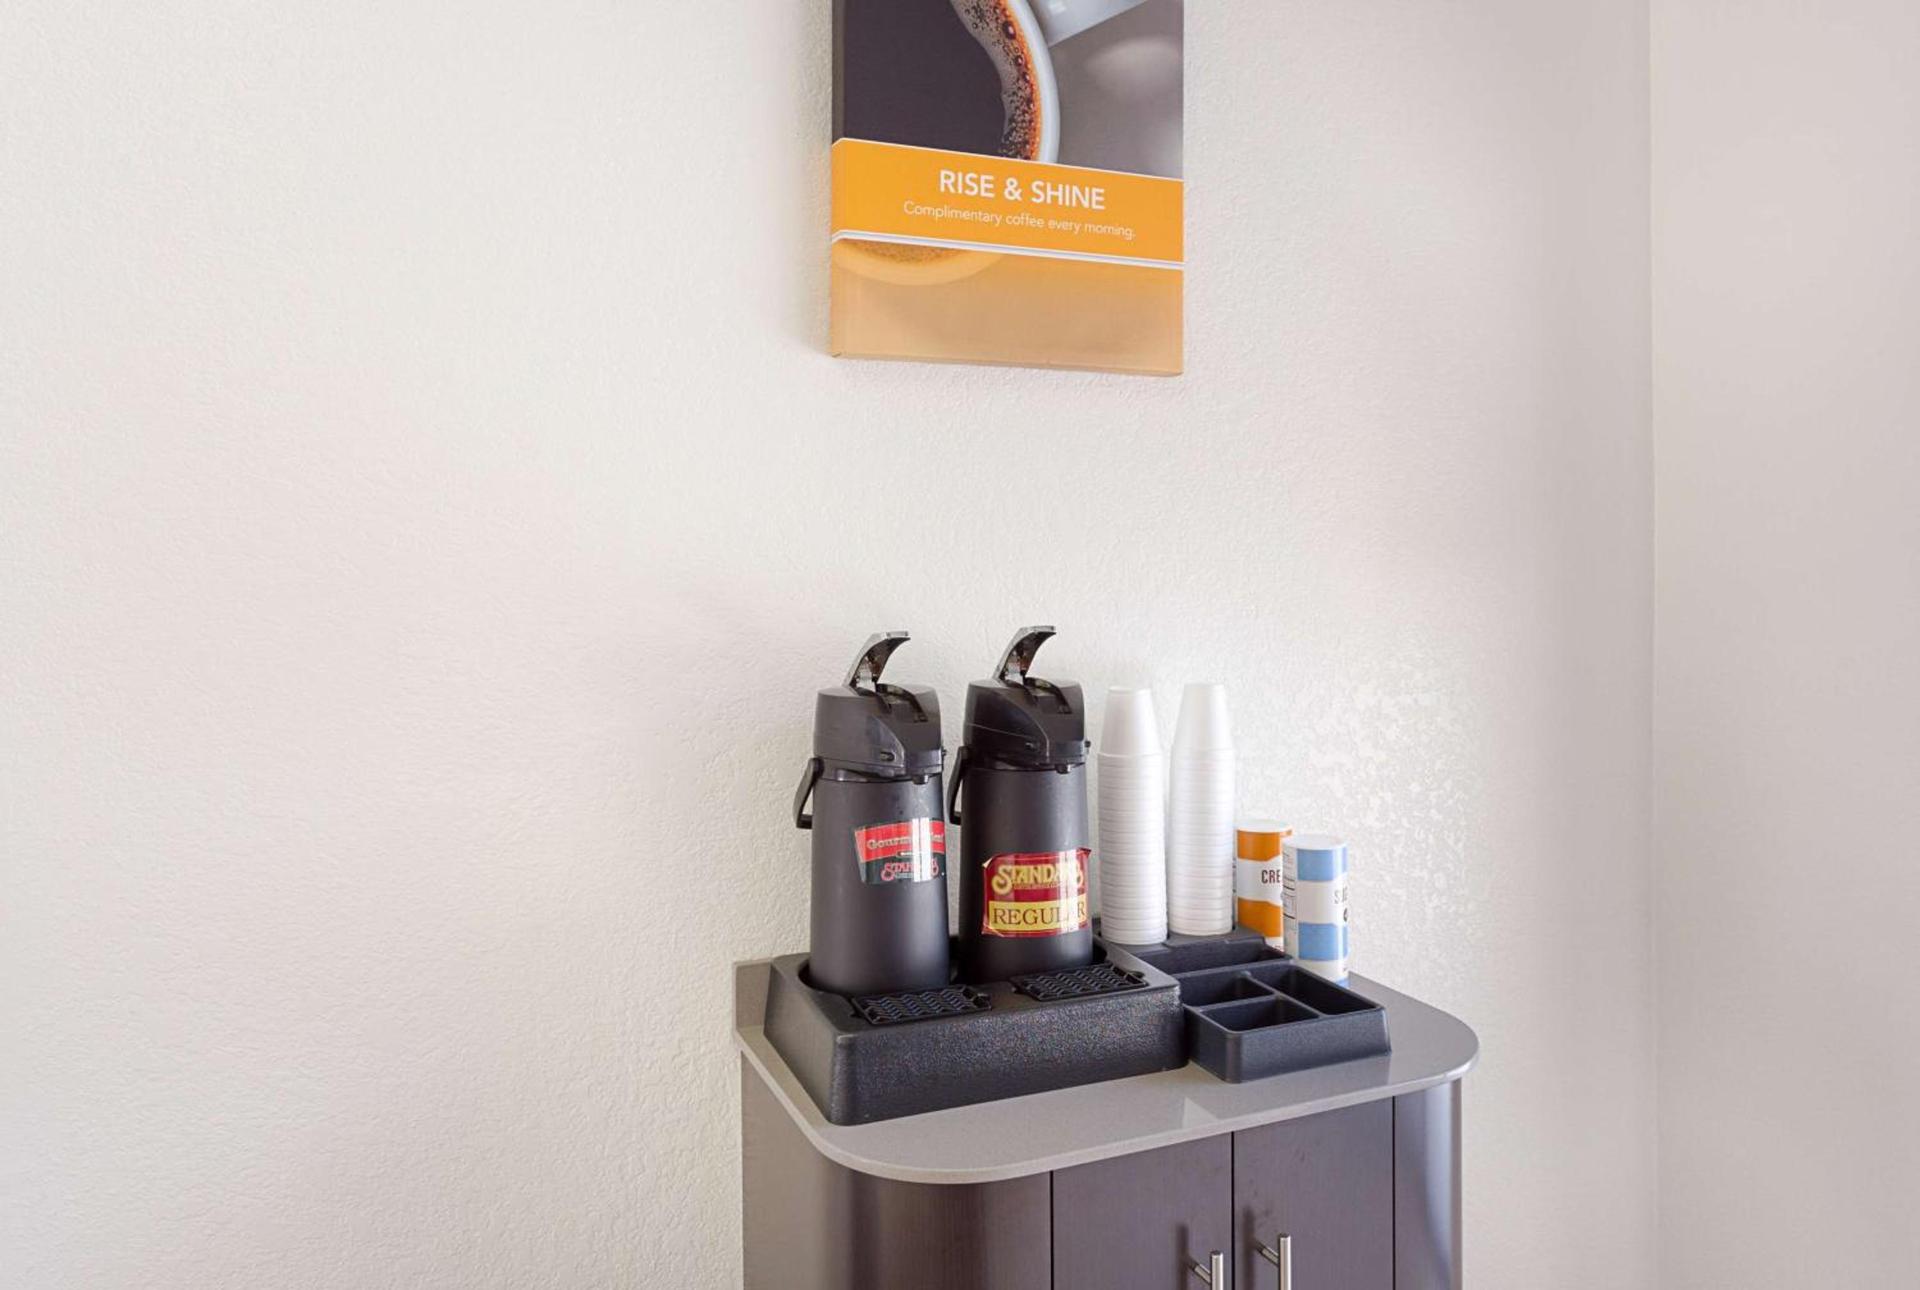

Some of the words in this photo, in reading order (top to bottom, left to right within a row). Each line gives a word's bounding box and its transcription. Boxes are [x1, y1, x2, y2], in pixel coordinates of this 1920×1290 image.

[939, 169, 996, 198] RISE
[1004, 177, 1022, 201] &
[1031, 180, 1105, 210] SHINE
[903, 200, 1002, 226] Complimentary
[1005, 212, 1045, 228] coffee
[1048, 219, 1081, 234] every
[1084, 223, 1136, 241] morning.
[993, 902, 1085, 925] REGULR
